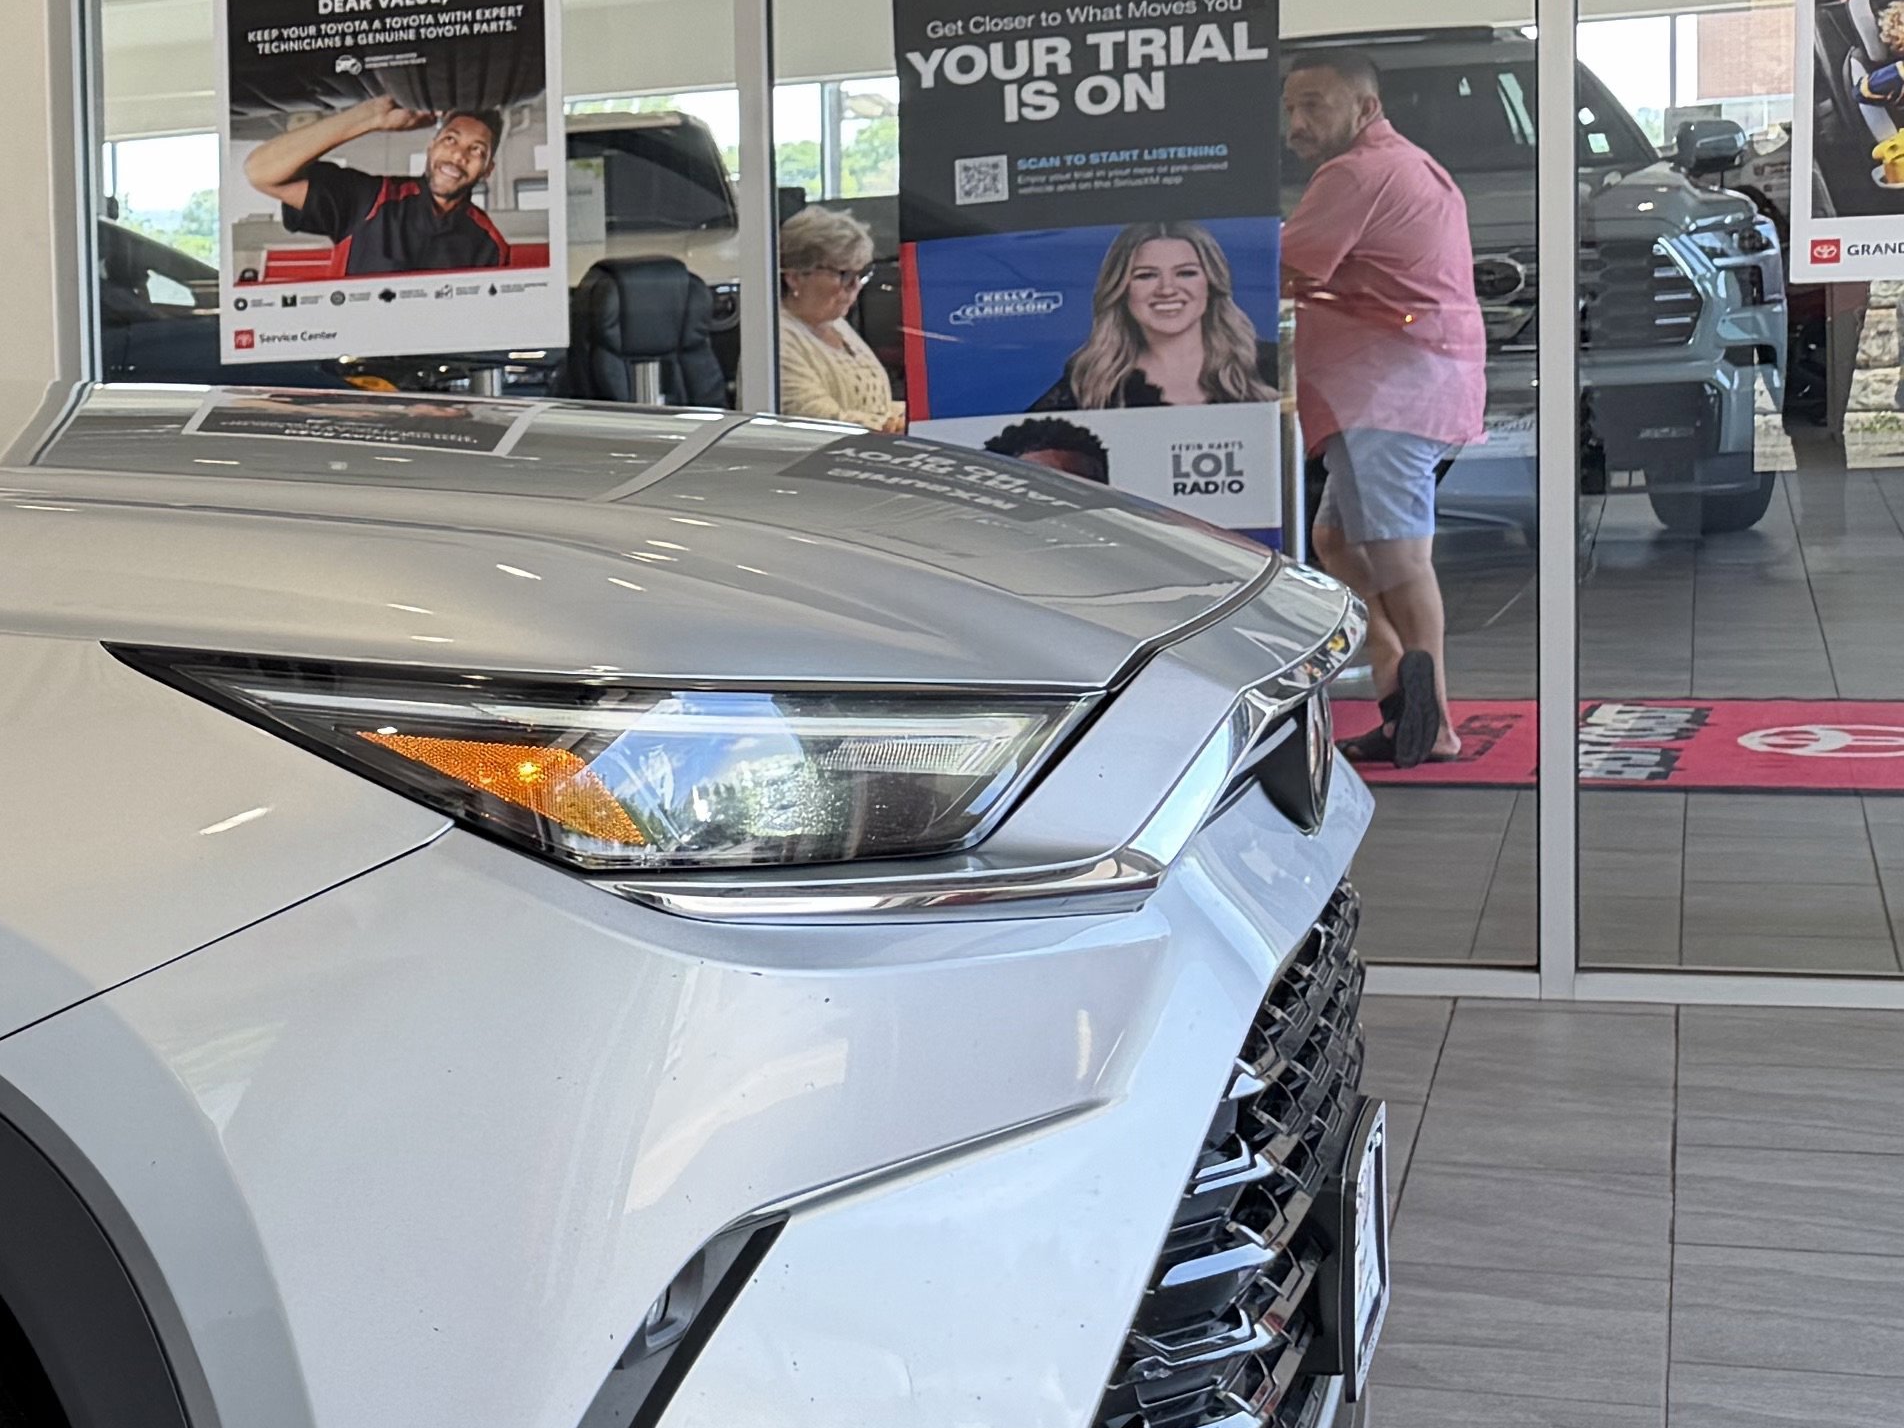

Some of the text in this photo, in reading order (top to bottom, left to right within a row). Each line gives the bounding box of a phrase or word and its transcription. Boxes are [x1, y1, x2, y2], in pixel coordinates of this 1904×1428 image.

[247, 4, 524, 43] KEEP YOUR TOYOTA A TOYOTA WITH EXPERT
[256, 35, 342, 55] TECHNICIANS
[356, 28, 417, 46] GENUINE
[420, 22, 470, 40] TOYOTA
[472, 19, 517, 35] PARTS.
[926, 19, 965, 39] Get
[968, 12, 1036, 34] Closer
[1039, 10, 1062, 26] to
[1065, 3, 1123, 24] What
[905, 21, 1269, 90] YOUR TRIAL
[1003, 70, 1166, 123] IS ON
[1016, 143, 1228, 171] SCAN TO START LISTENING
[300, 331, 338, 342] Center
[1171, 451, 1244, 479] LOL
[1172, 479, 1245, 497] RADIO
